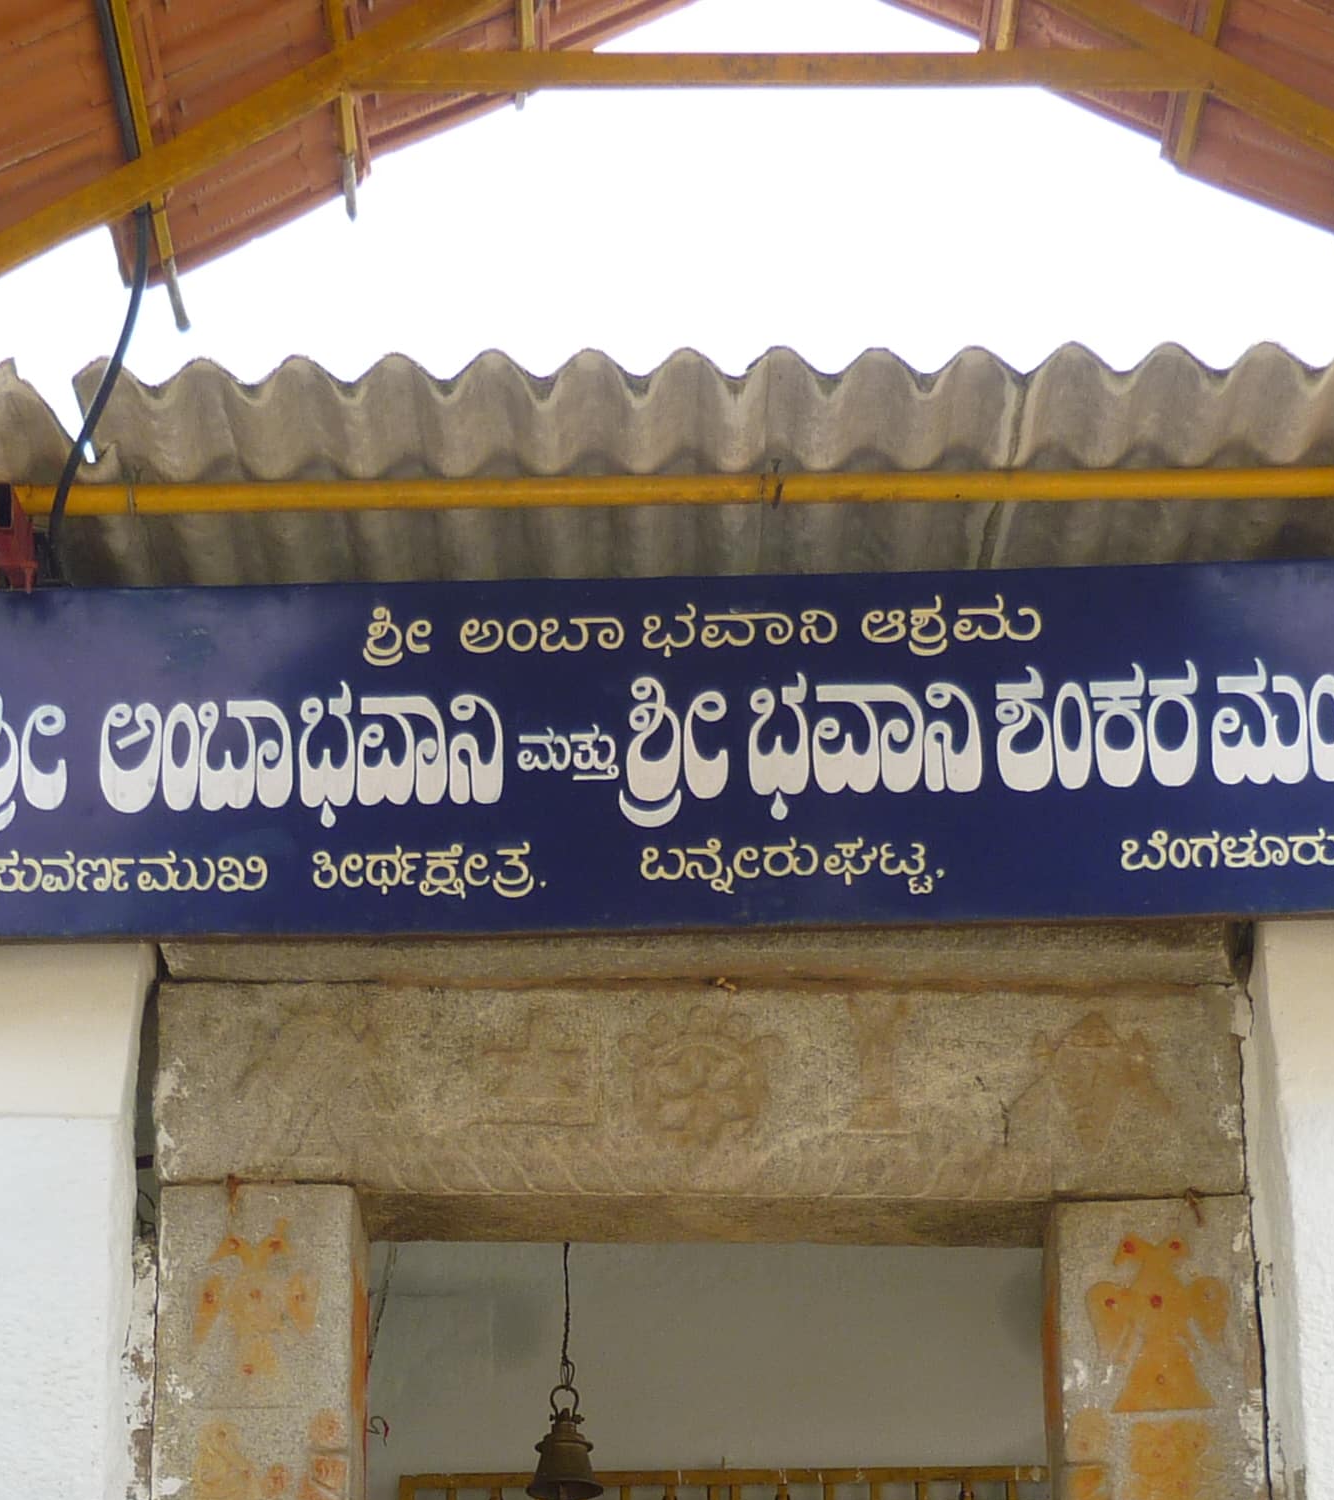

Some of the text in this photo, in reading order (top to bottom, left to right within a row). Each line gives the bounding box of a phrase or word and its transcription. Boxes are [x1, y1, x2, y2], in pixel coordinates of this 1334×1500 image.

[363, 594, 1042, 666] ಶ್ರೀ ಅಂಬಾ ಭವಾನಿ ಆಶ್ರಮ
[516, 724, 619, 780] ಮತ್ತು
[619, 676, 729, 828] ಶ್ರೀ
